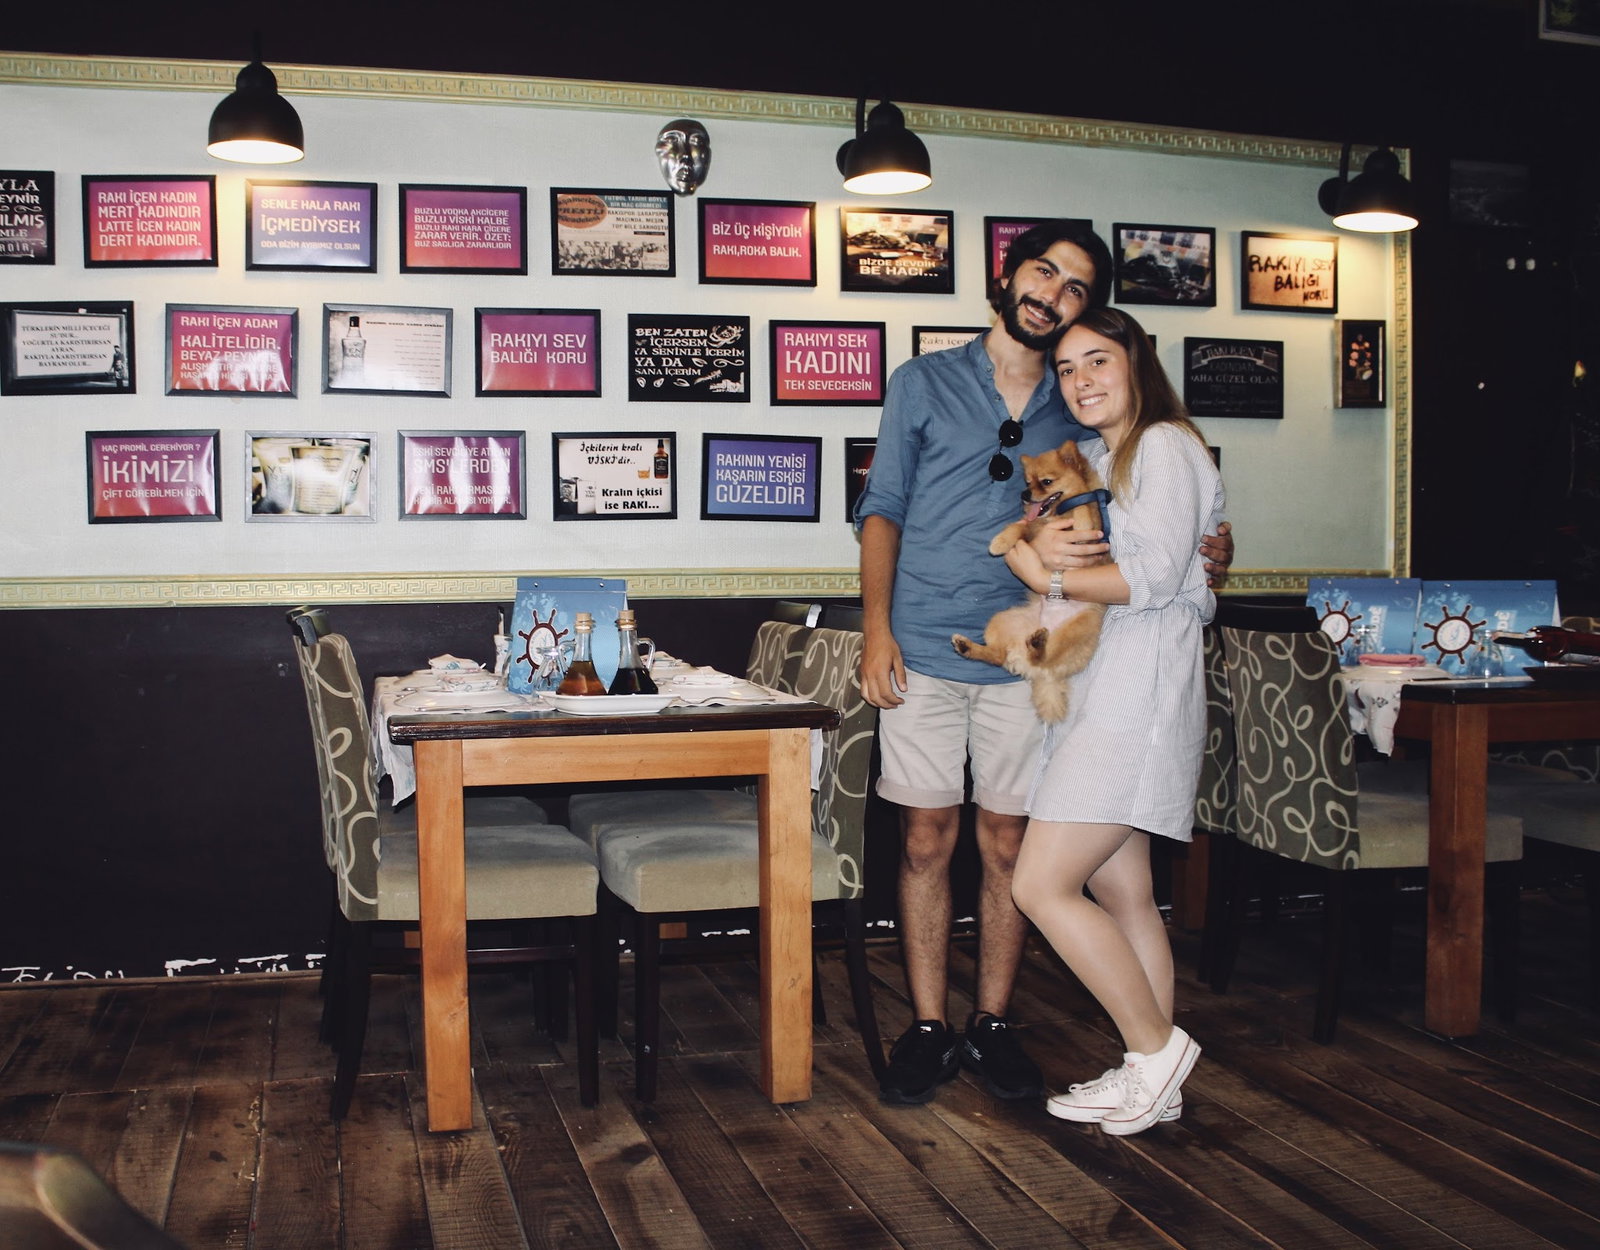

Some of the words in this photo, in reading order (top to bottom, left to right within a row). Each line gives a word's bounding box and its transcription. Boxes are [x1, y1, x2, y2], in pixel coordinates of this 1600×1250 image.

[98, 192, 126, 204] RAKI
[130, 190, 157, 206] İÇEN
[160, 192, 197, 203] KADIN
[260, 199, 298, 210] SENLE
[301, 200, 331, 211] HALA
[334, 201, 360, 212] RAKI
[98, 206, 134, 218] MERT
[138, 206, 200, 218] KADINDIR
[98, 221, 134, 232] LATTE
[166, 220, 200, 232] KADIN
[260, 214, 360, 236] İÇMEDİYSEK
[414, 215, 446, 224] BUZLU
[449, 215, 475, 224] VİSKİ
[477, 217, 508, 226] KALBE
[414, 232, 448, 240] ZARAR
[712, 222, 732, 236] BİZ
[734, 222, 750, 240] ÜÇ
[753, 222, 802, 240] KİŞİYDİK
[100, 234, 134, 246] DERT
[137, 234, 202, 246] KADINDIR.
[770, 246, 802, 257] BALIK.
[859, 258, 892, 266] BİZDE
[895, 260, 936, 268] SEVDİK
[1248, 254, 1306, 272] RAKIYI
[860, 266, 881, 274] BE
[886, 266, 938, 276] HACI...
[181, 316, 210, 326] RAKI
[212, 316, 240, 330] İÇEN
[244, 318, 278, 328] ADAM
[636, 328, 660, 336] BEN
[664, 328, 708, 337] ZATEN
[181, 333, 281, 350] KALİTELİDİR.
[490, 333, 547, 347] RAKIYI
[552, 334, 586, 348] SEV
[650, 336, 708, 348] İÇERSEM
[784, 332, 833, 347] RAKIYI
[838, 334, 867, 348] SEK
[181, 350, 220, 360] BEYAZ
[224, 351, 277, 361] PEYNE
[490, 348, 537, 364] BALIĞI
[546, 352, 586, 364] KORU
[652, 347, 702, 356] SENİNLE
[635, 357, 656, 366] YA
[662, 358, 683, 366] DA
[786, 350, 870, 374] KADINI
[784, 380, 805, 390] TEK
[808, 379, 872, 391] SEVECEKSİN
[1250, 376, 1278, 384] OLAN
[102, 445, 118, 453] KAÇ
[120, 443, 149, 452] PROMİL
[580, 442, 618, 454] İçkilerin
[716, 454, 765, 467] RAKININ
[768, 454, 806, 468] YENİSİ
[102, 454, 194, 483] İKİMİZİ
[716, 469, 766, 485] KAŞARIN
[769, 469, 805, 484] ESKİSİ
[103, 488, 123, 500] ÇİFT
[125, 487, 184, 498] GÖREBİLMEK
[636, 488, 662, 498] içkisi
[716, 483, 805, 504] GÜZELDİR
[604, 501, 618, 510] ise
[623, 501, 659, 509] RAKI...
